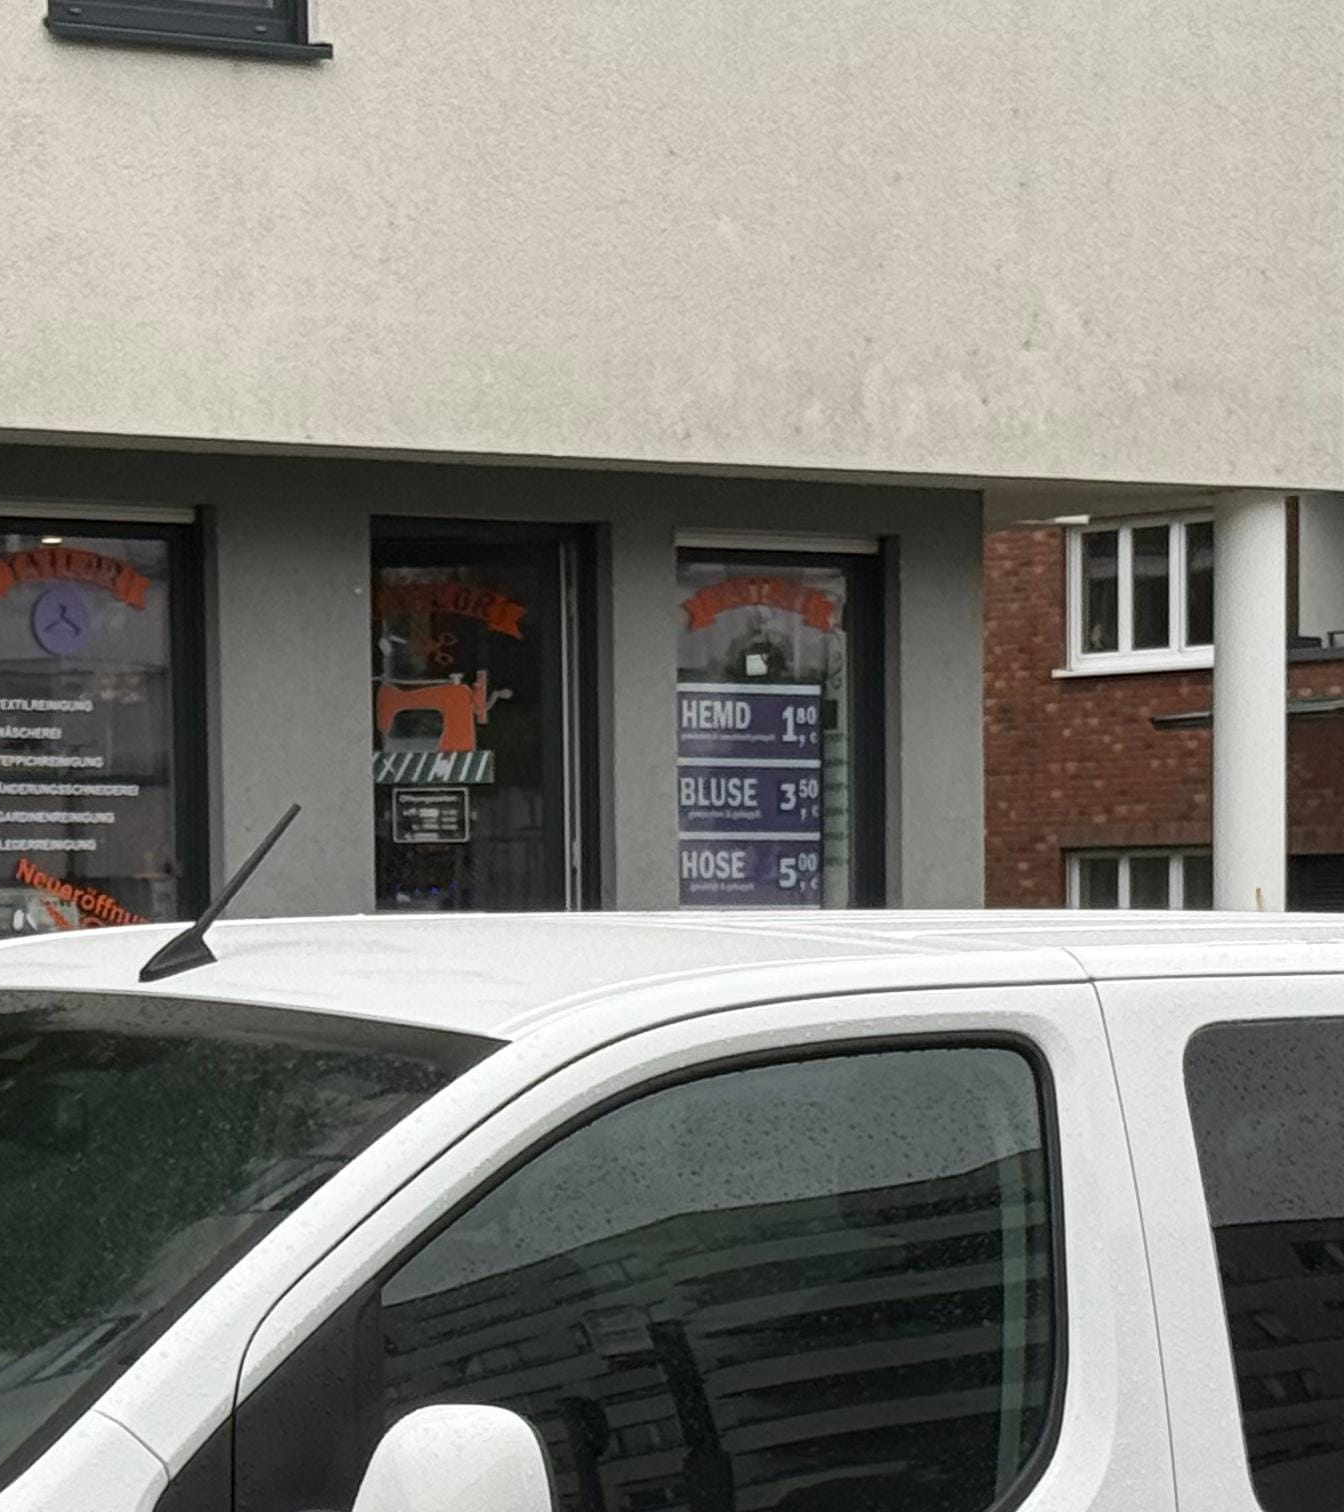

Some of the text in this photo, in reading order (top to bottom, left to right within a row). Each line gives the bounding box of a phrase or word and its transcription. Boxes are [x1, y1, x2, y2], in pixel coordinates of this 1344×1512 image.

[681, 699, 752, 730] HEMD
[679, 777, 759, 807] BLUSE
[681, 850, 747, 879] HOSE
